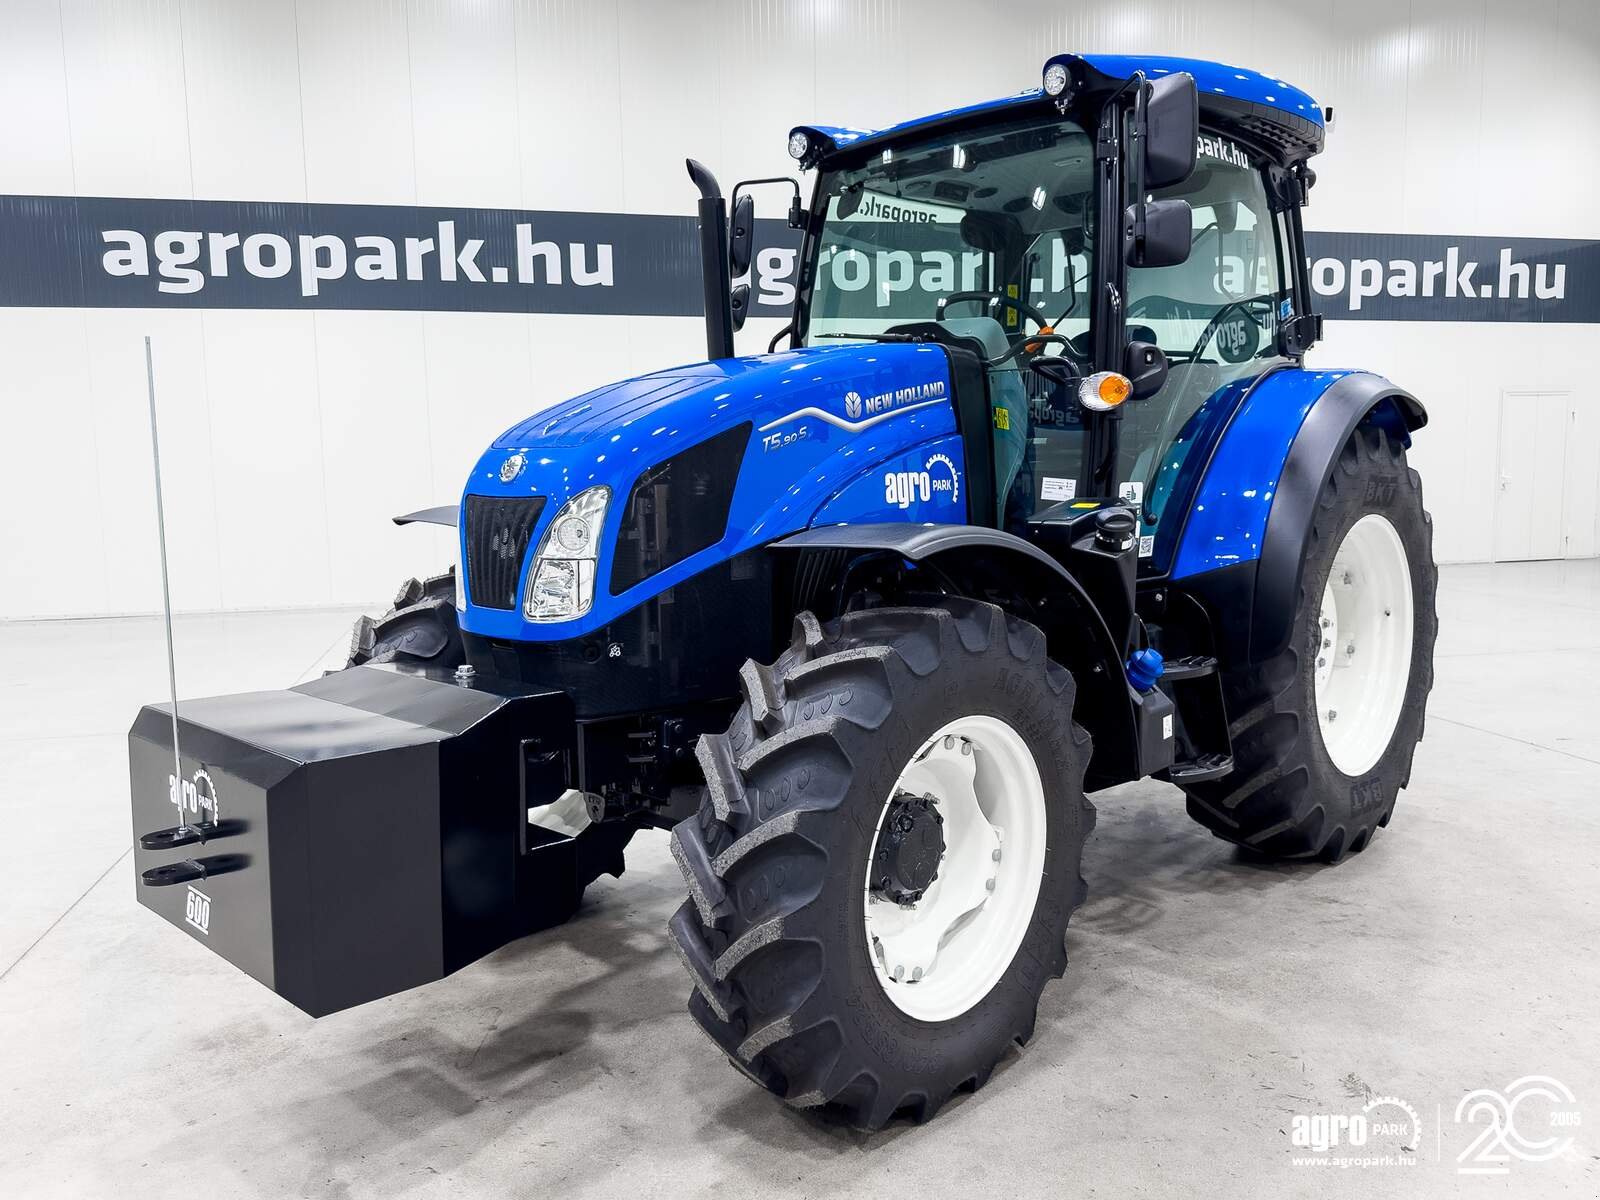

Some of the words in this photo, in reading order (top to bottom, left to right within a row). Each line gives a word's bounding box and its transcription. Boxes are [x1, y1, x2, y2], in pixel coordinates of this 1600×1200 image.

[101, 220, 614, 297] agropark.hu
[865, 396, 893, 414] NEW
[895, 381, 945, 402] HOLLAND
[885, 471, 931, 509] agro
[932, 479, 952, 492] PARK
[198, 794, 213, 812] PARK
[186, 891, 210, 930] 600
